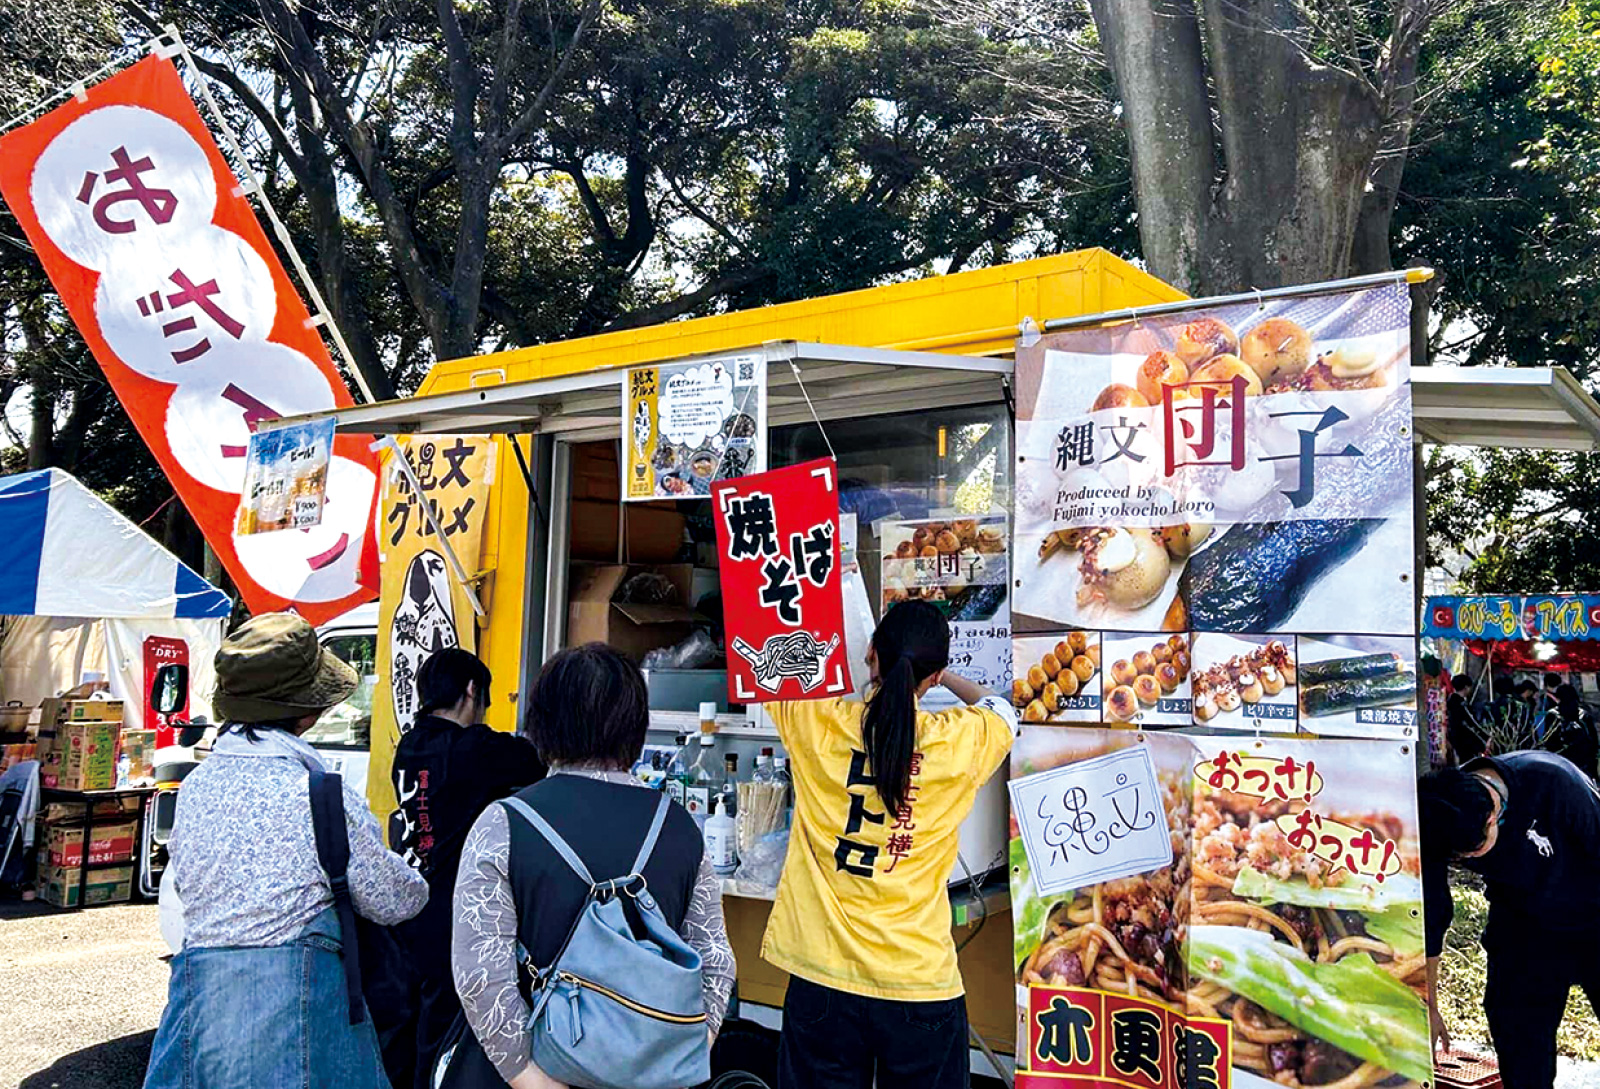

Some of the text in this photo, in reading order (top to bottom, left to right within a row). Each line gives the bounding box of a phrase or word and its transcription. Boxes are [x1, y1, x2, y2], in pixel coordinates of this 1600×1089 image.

[1055, 374, 1364, 508] 縄文団子
[1053, 503, 1095, 522] Fujimi
[1098, 503, 1168, 518] yokocho
[1056, 486, 1156, 505] Produceed by
[388, 495, 476, 547] グルメ
[728, 492, 834, 625] 焼そば
[1538, 599, 1588, 637] アイス
[1059, 697, 1097, 708] みたらし
